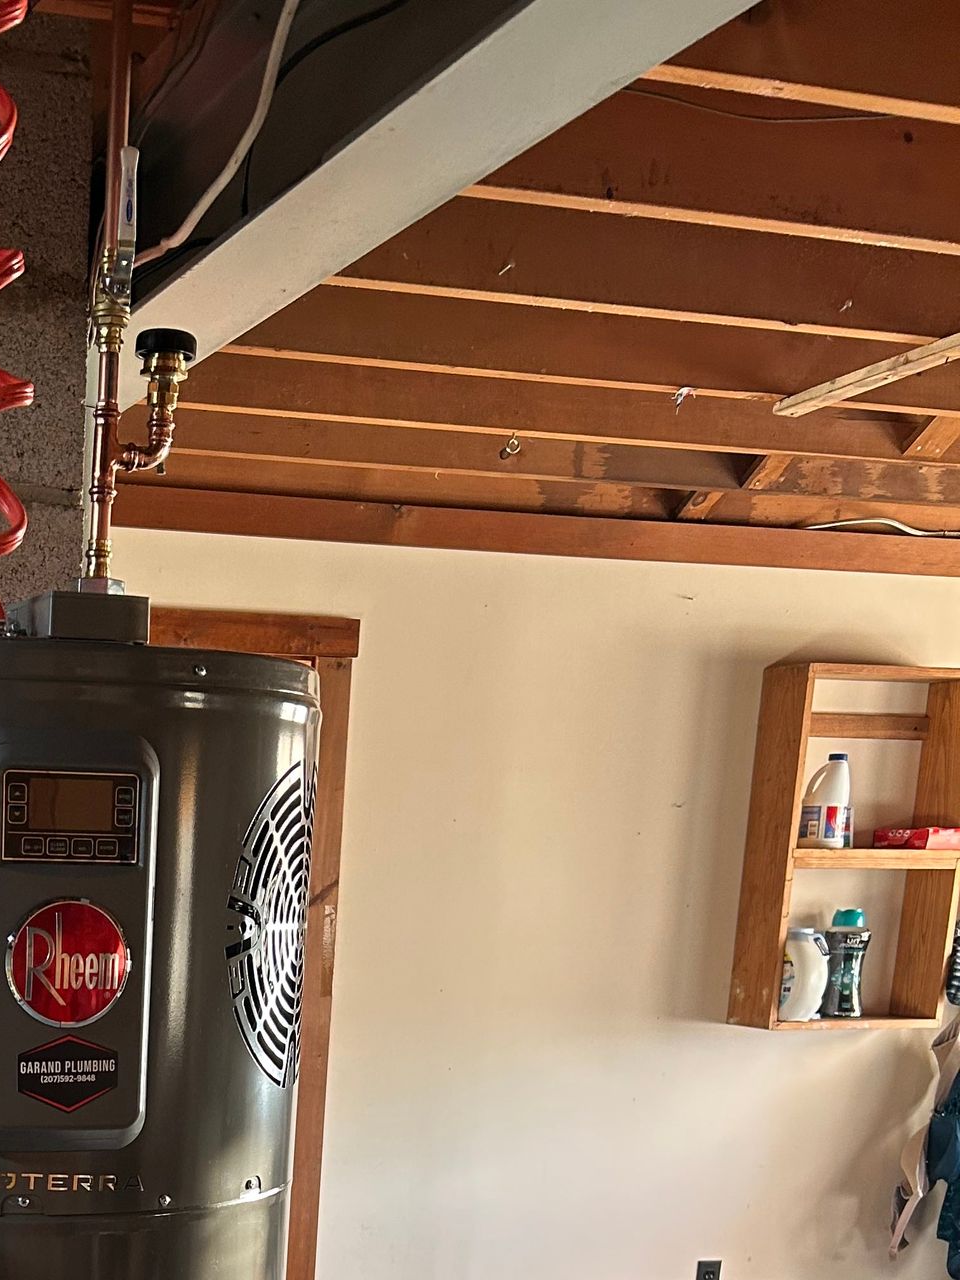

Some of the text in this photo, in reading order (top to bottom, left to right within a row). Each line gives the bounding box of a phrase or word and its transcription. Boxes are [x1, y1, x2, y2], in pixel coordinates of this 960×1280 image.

[24, 912, 120, 1006] Rheem
[20, 1059, 116, 1074] GARAND PLUMBING
